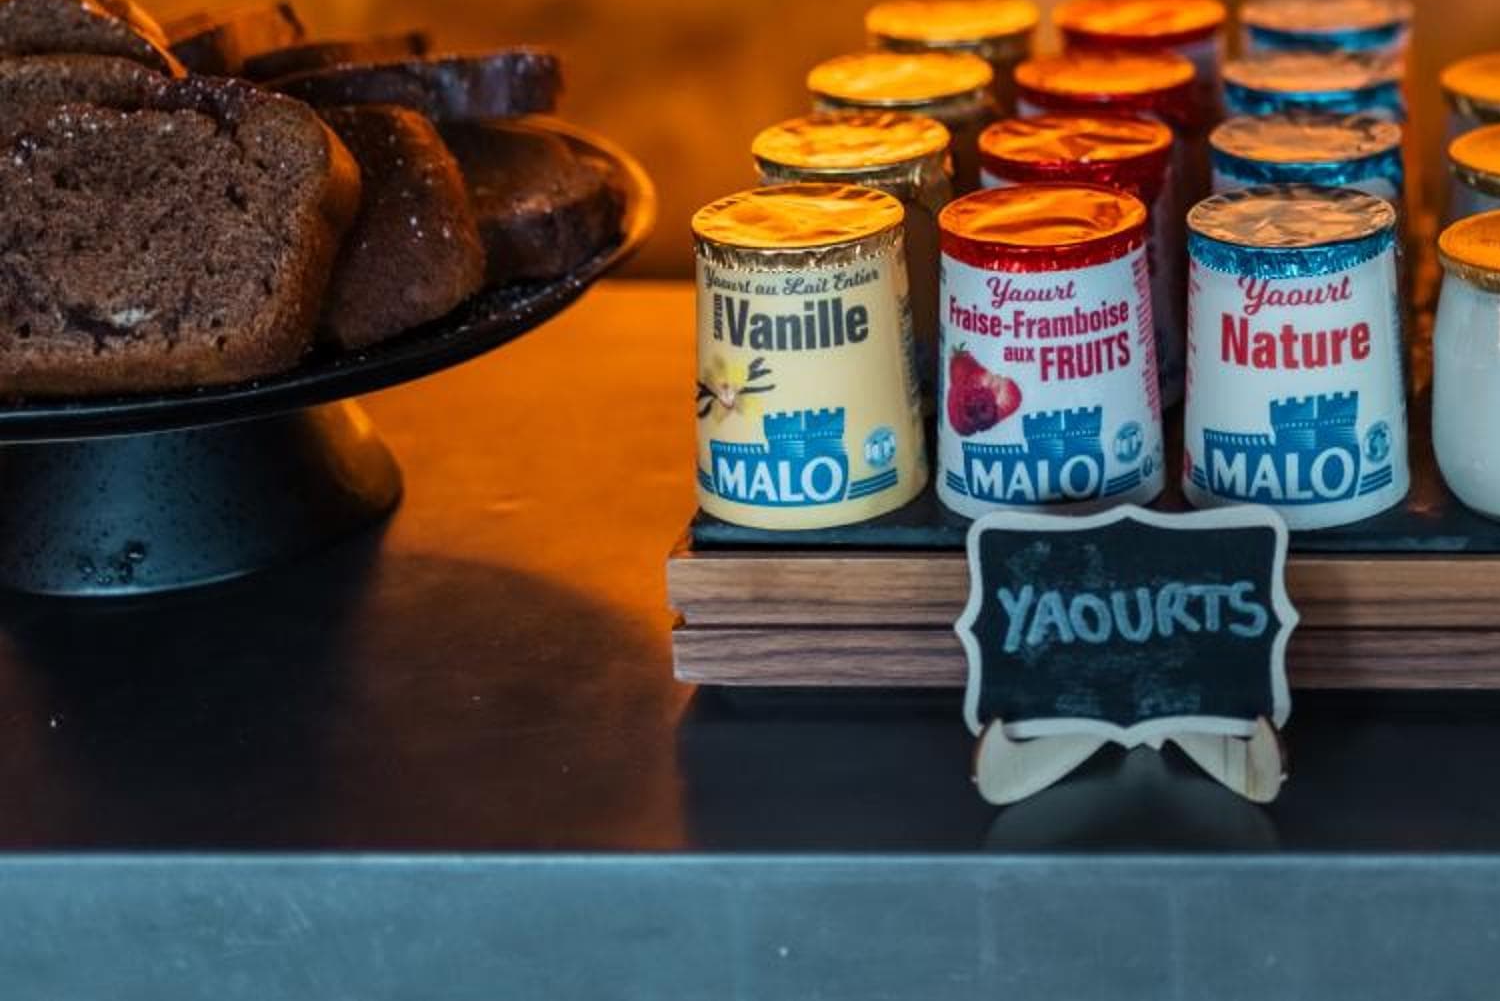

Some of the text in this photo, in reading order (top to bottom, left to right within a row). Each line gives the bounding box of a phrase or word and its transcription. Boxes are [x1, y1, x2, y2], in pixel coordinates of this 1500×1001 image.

[754, 283, 778, 296] au
[783, 275, 829, 296] Lait
[833, 266, 880, 291] Entier
[986, 276, 1076, 309] Yaourt
[1237, 275, 1352, 316] Yaourt
[725, 296, 869, 351] Vanille
[949, 295, 1130, 339] Fraise-Framboise
[1003, 330, 1131, 382] aux FRUITS
[1220, 312, 1371, 370] Nature
[716, 456, 843, 502] MALO
[971, 454, 1099, 501] MALO
[1212, 446, 1355, 499] MALO
[996, 581, 1269, 654] YAOURTS
